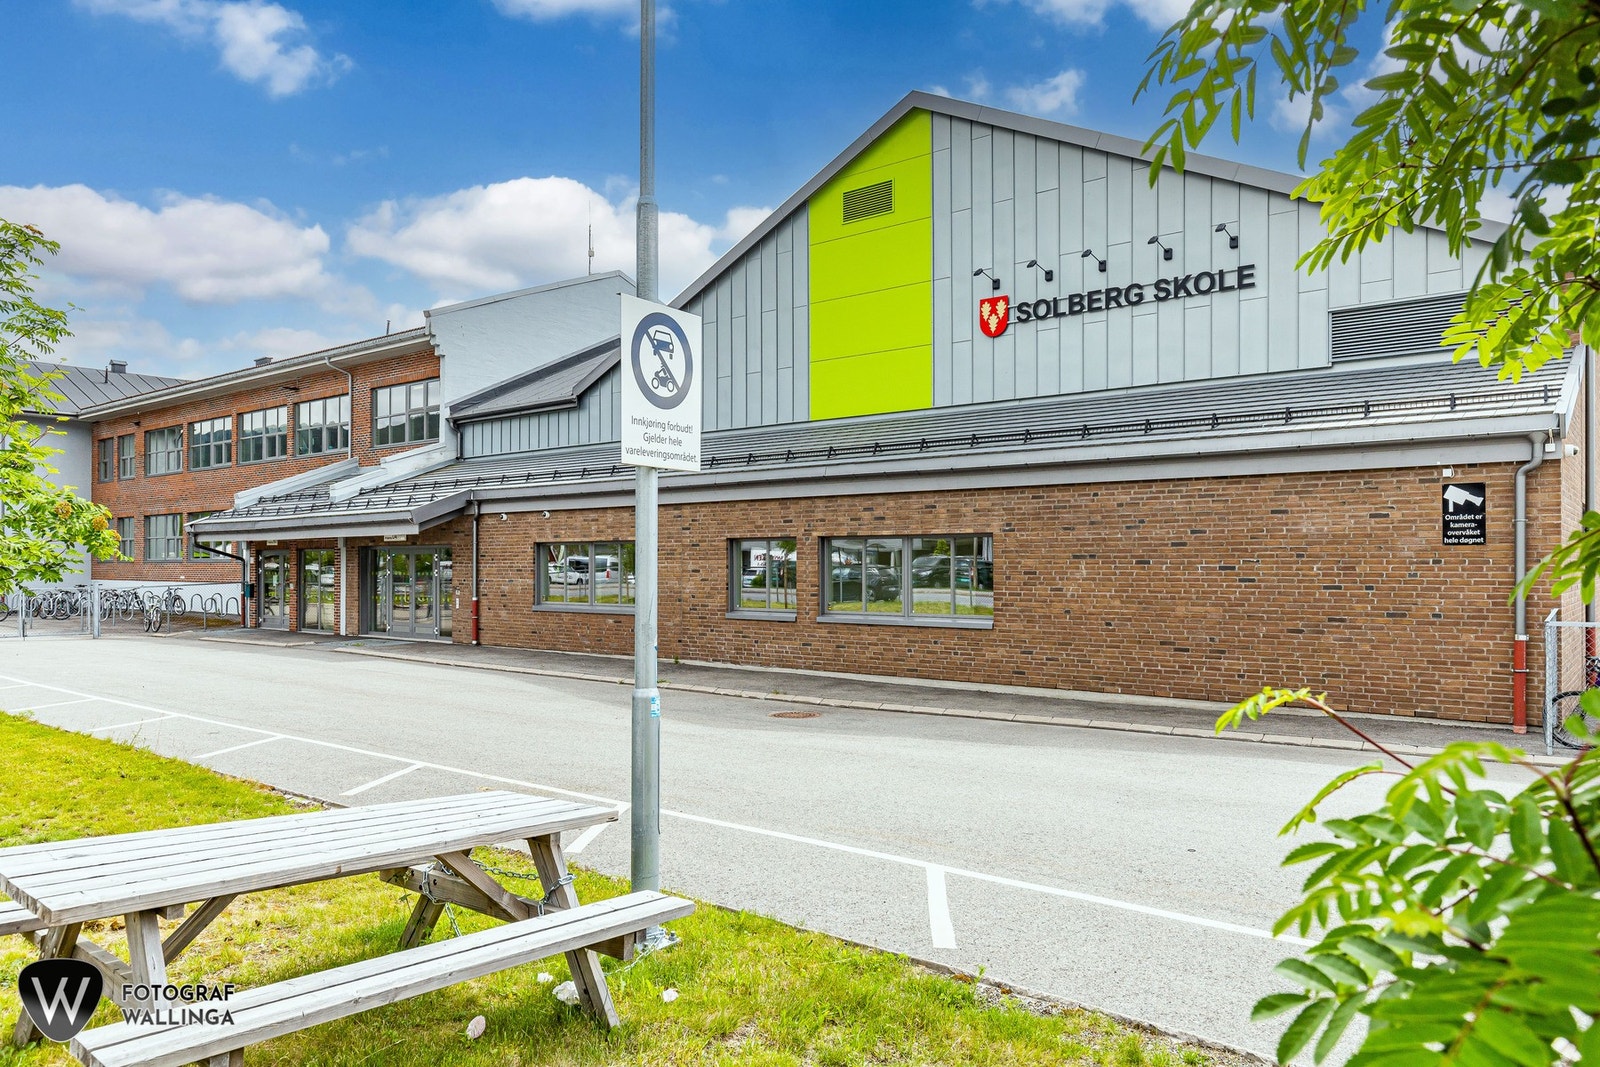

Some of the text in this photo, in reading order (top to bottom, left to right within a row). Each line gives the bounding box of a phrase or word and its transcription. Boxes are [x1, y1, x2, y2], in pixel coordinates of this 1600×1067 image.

[1016, 264, 1256, 323] SOLBERG SKOLE
[631, 415, 666, 432] Innkjøring
[643, 432, 683, 447] Gjelder hele
[1459, 537, 1484, 545] døgnet
